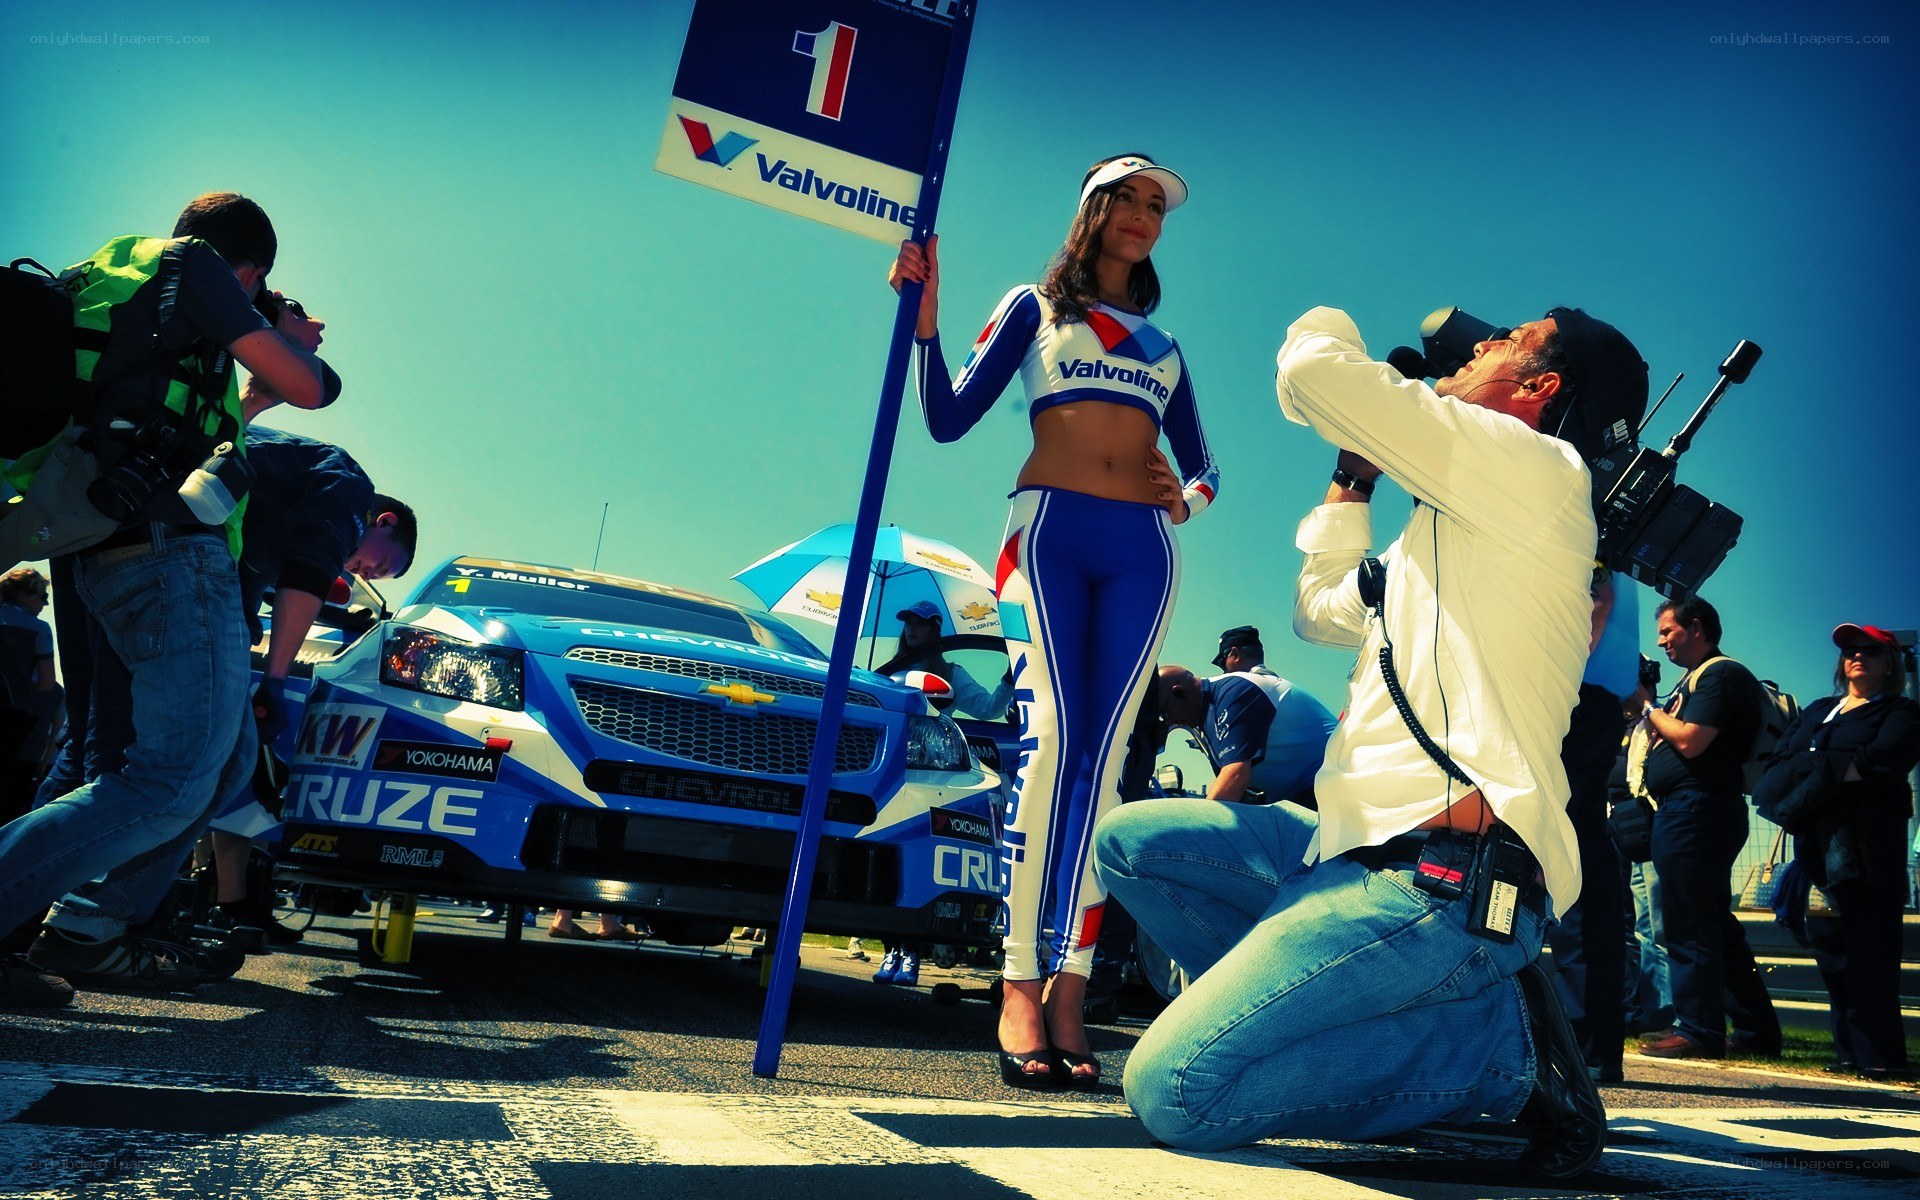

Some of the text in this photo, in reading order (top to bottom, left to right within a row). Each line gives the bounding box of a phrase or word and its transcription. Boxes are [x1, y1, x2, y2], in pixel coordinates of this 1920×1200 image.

[792, 20, 858, 122] 1
[756, 152, 919, 229] Valvoline
[1058, 358, 1169, 402] Valvoline
[445, 578, 471, 593] 1
[456, 567, 590, 592] Y. Muller
[580, 627, 830, 673] CHEVROLE
[406, 750, 494, 773] YOKOHAMA
[281, 773, 484, 837] CRUZE
[619, 770, 841, 821] CHEVROLT
[950, 817, 991, 839] YOKOHAMA
[380, 845, 433, 866] RML
[1489, 902, 1500, 930] THOMAS
